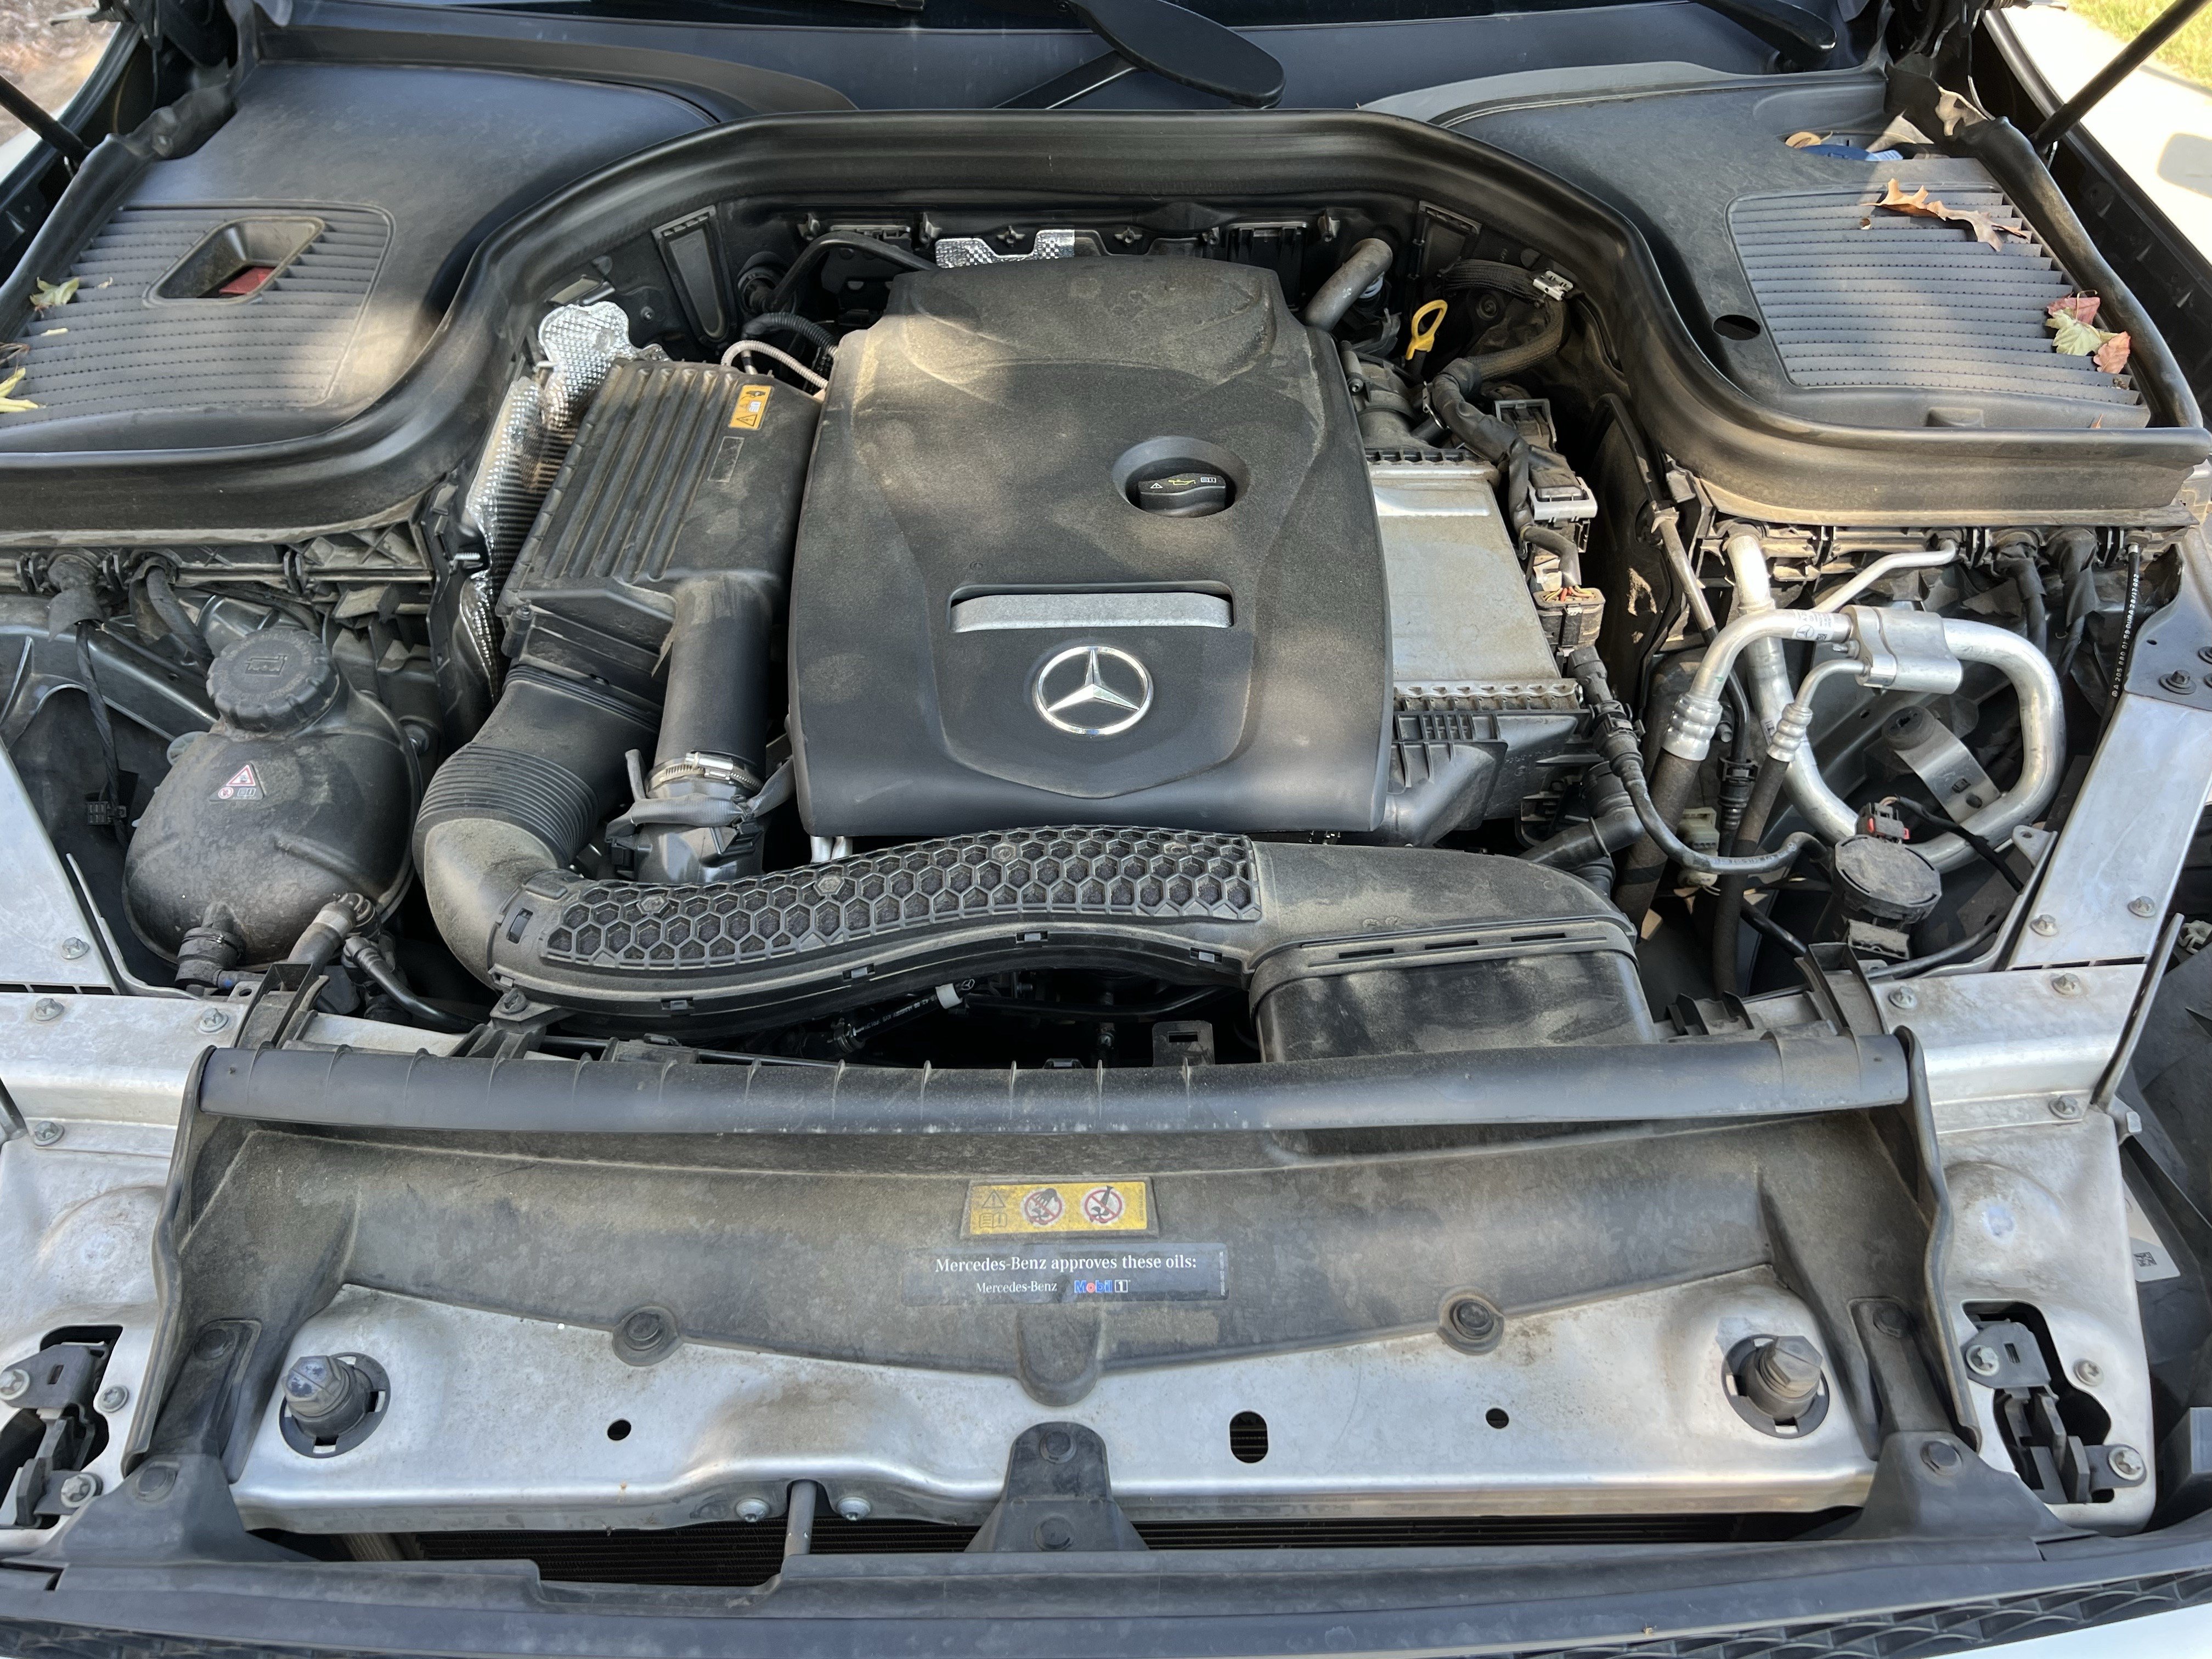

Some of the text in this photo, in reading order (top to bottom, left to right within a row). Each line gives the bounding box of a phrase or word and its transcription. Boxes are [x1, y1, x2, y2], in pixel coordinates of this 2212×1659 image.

[2125, 610, 2134, 629] DURA
[935, 1254, 1197, 1273] Mercedes-Benz approves these oils:
[976, 1280, 1058, 1294] Mercedes-Benz
[1074, 1279, 1113, 1294] Mobil
